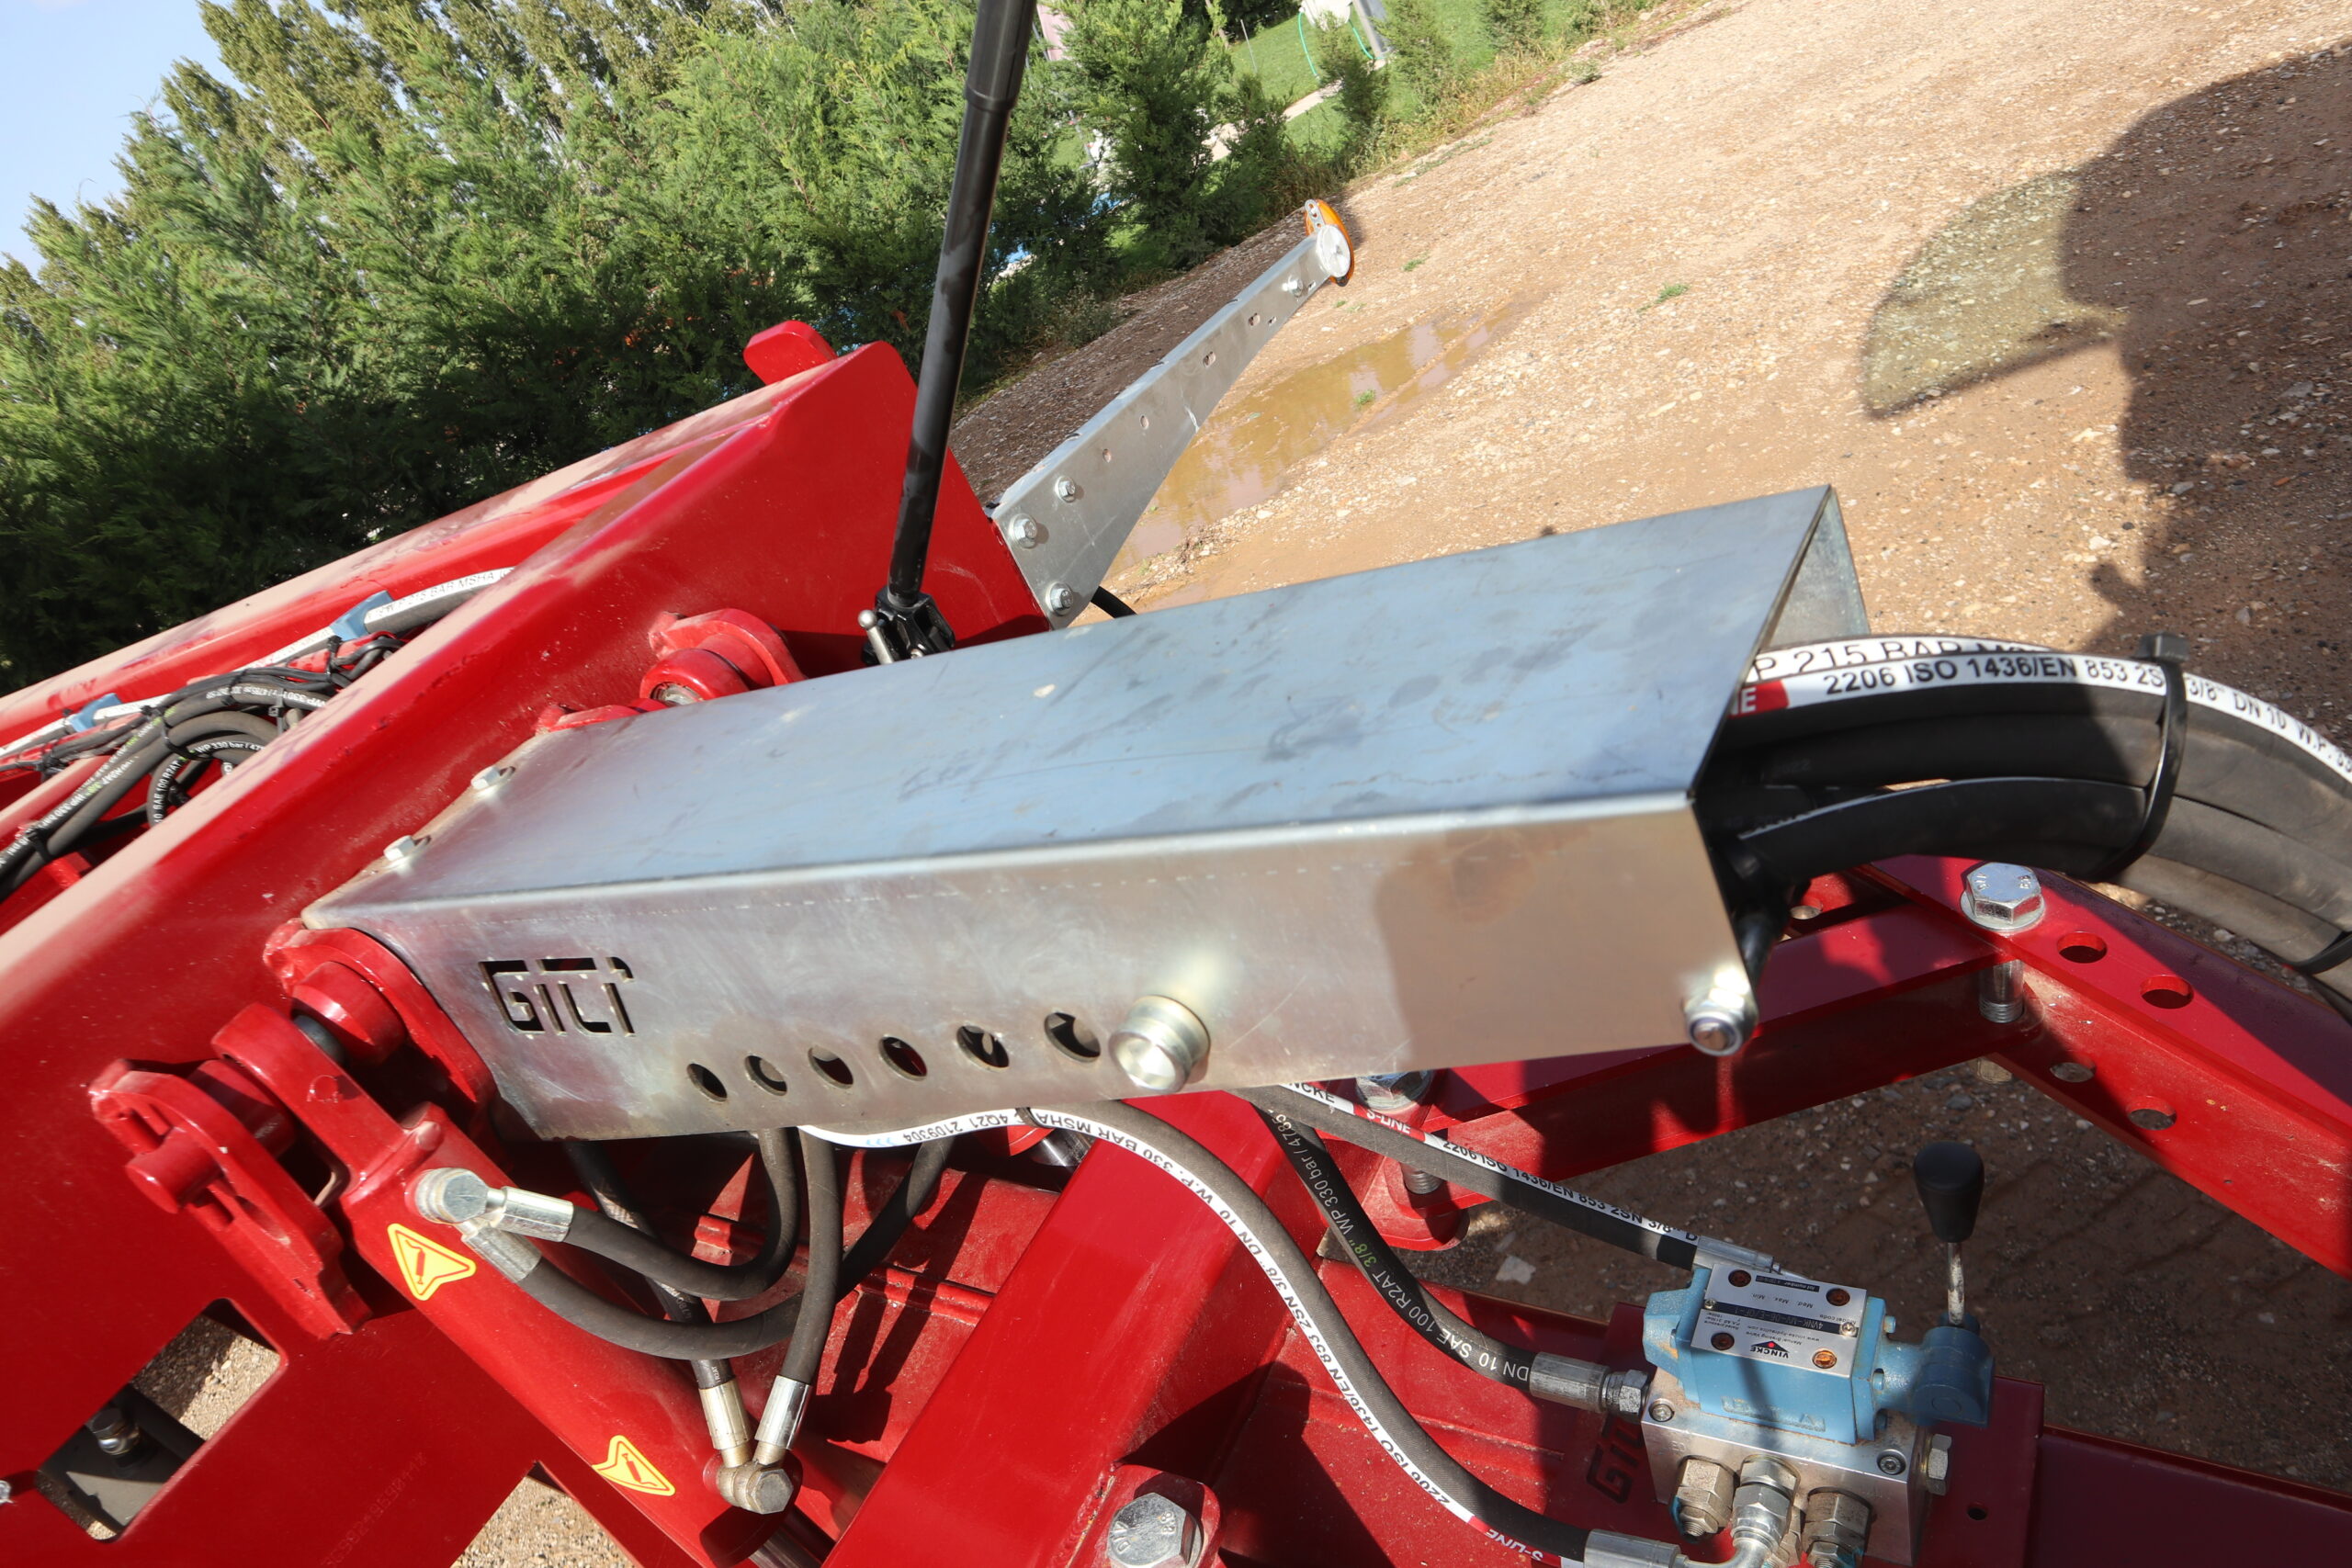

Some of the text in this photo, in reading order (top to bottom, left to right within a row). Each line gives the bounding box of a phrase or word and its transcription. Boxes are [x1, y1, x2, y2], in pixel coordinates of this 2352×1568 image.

[1793, 645, 1868, 672] 215
[1823, 667, 1896, 695] 2206
[1905, 660, 1959, 683] ISO
[1966, 657, 2078, 679] 1436/EN
[2085, 660, 2129, 682] 853
[2135, 664, 2166, 688] 2S
[2233, 693, 2261, 719] DN
[2267, 705, 2288, 730] 10
[211, 741, 228, 750] 330
[902, 1120, 964, 1144] 2109304
[967, 1112, 1009, 1129] 4Q21
[1035, 1112, 1092, 1134] MSHA
[1272, 1112, 1302, 1147] 4785
[1097, 1126, 1138, 1153] BAR
[1142, 1148, 1174, 1173] 330
[1301, 1156, 1324, 1180] bar
[1366, 1110, 1411, 1134] S-LINE
[1442, 1141, 1477, 1160] 2206
[1480, 1155, 1508, 1172] ISO
[1513, 1168, 1574, 1199] 1436/EN
[1578, 1193, 1606, 1210] 853
[1611, 1204, 1643, 1224] 2SN
[1685, 1231, 1699, 1242] D
[1314, 1179, 1340, 1208] 330
[1219, 1209, 1238, 1228] 10
[1330, 1209, 1355, 1235] WP
[1238, 1231, 1262, 1256] DN
[1373, 1269, 1412, 1309] R2AT
[1284, 1295, 1312, 1329] 2SN
[1408, 1305, 1437, 1333] 100
[1308, 1334, 1332, 1364] 853
[1436, 1327, 1472, 1359] SAE
[1749, 1346, 1790, 1359] VINCKE
[1478, 1352, 1498, 1371] 10
[1502, 1360, 1530, 1382] DN
[1329, 1368, 1380, 1433] 1436/EN
[1380, 1439, 1410, 1470] ISO
[1411, 1471, 1451, 1505] 2206
[1486, 1528, 1544, 1562] S-LINE
